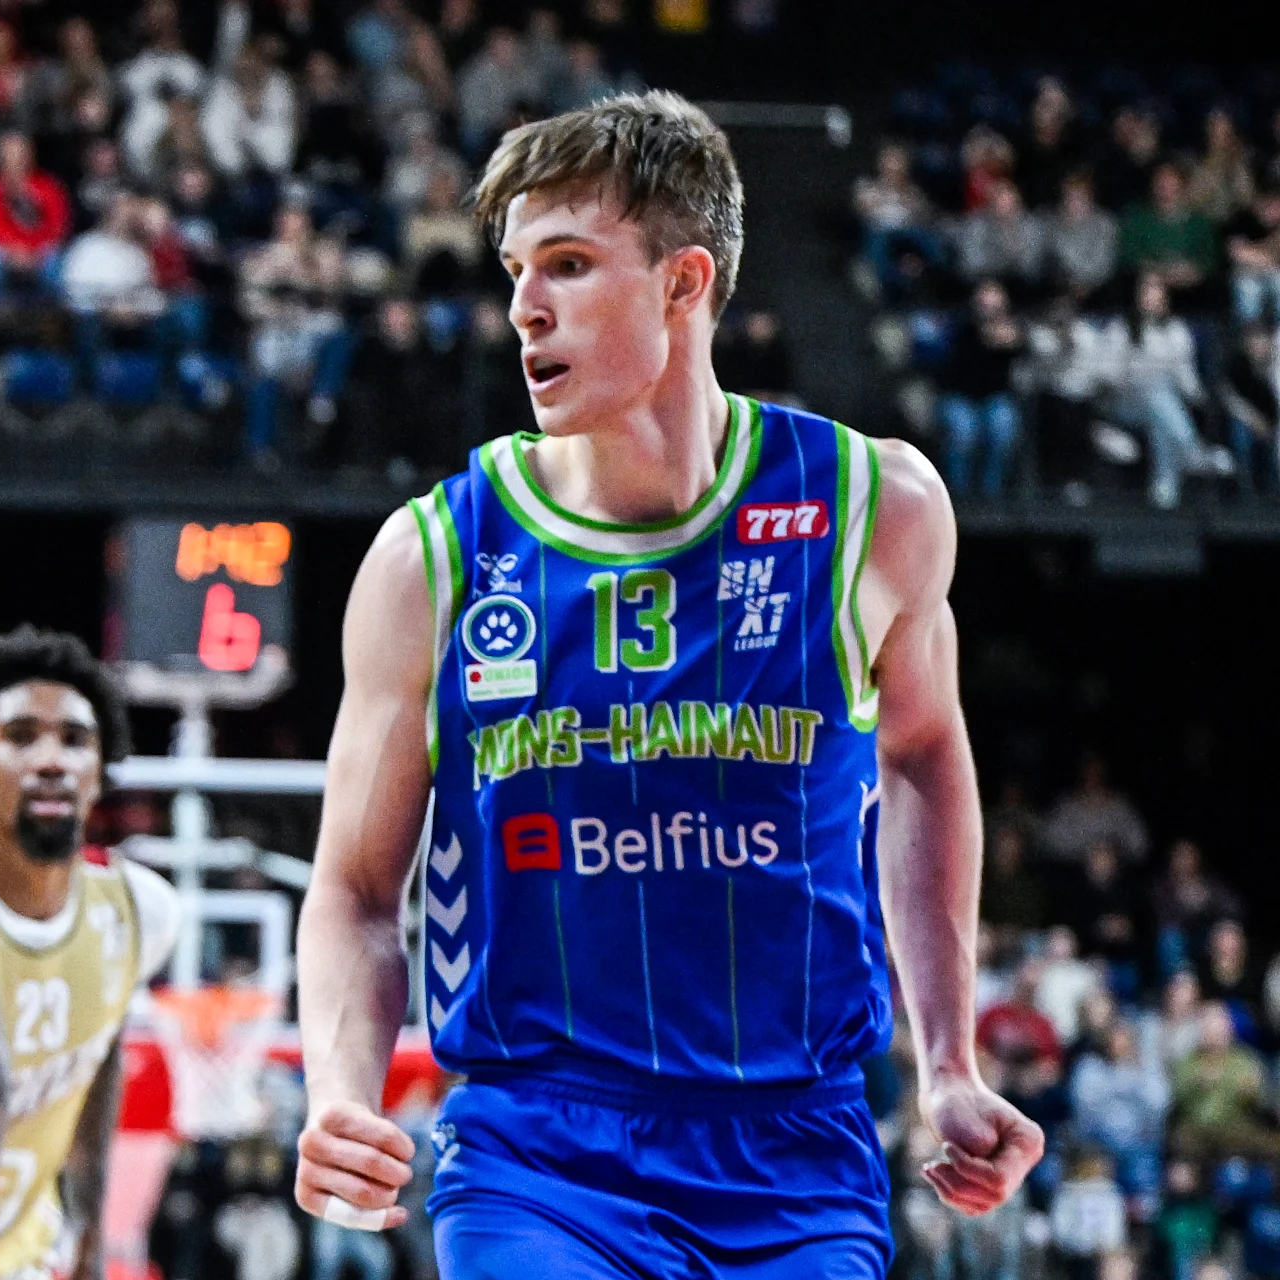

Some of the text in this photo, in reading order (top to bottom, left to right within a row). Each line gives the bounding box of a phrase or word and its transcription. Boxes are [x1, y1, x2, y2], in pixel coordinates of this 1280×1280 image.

[746, 505, 819, 539] 777
[586, 567, 676, 673] 13
[571, 811, 779, 876] Belfius
[13, 976, 70, 1053] 23
